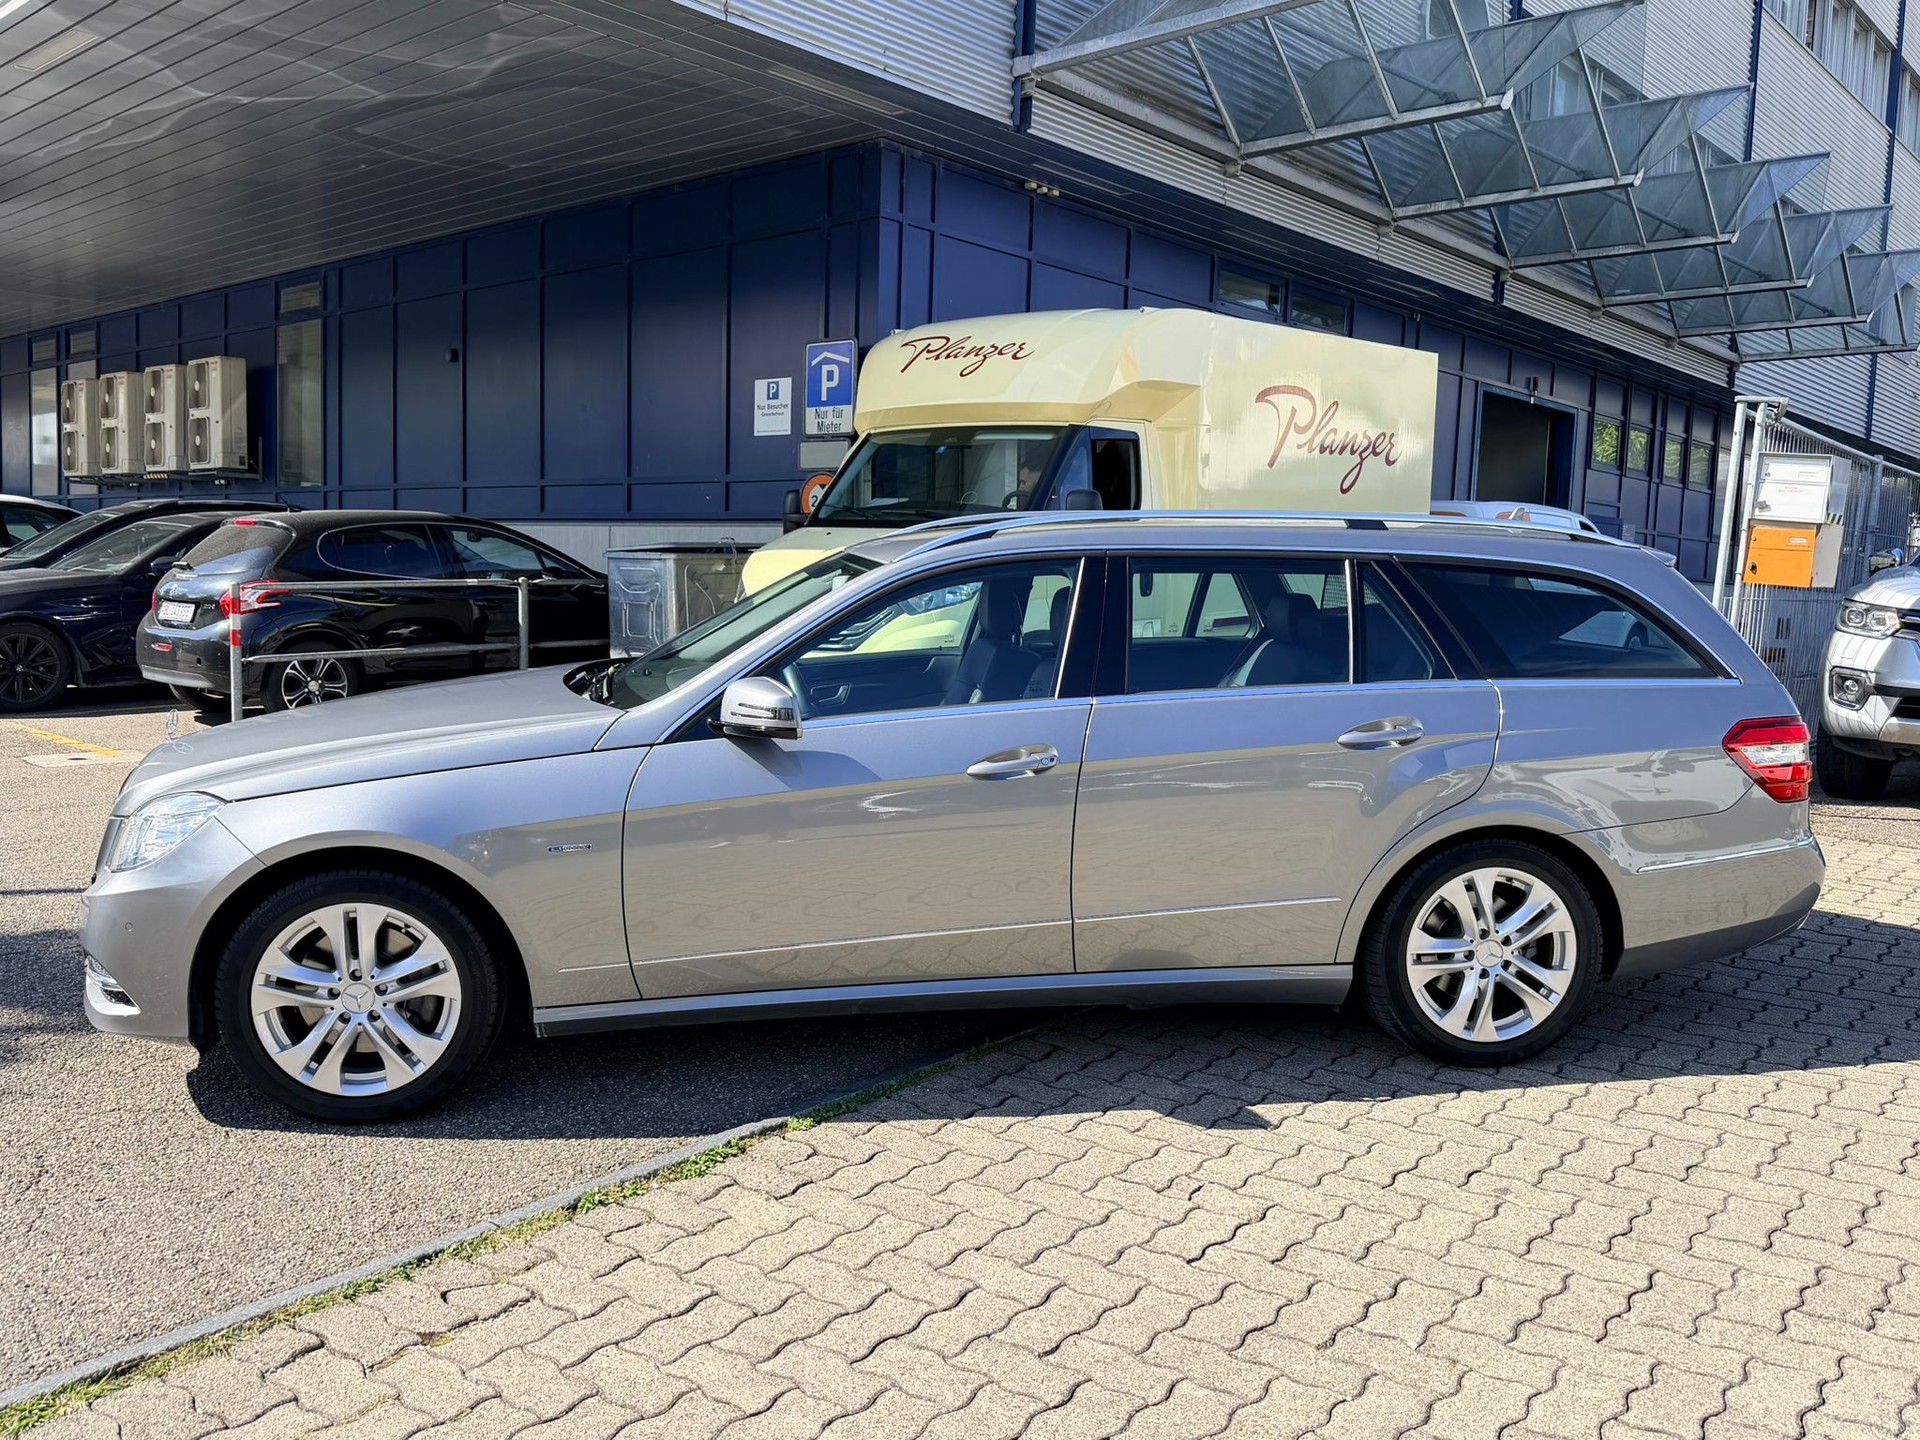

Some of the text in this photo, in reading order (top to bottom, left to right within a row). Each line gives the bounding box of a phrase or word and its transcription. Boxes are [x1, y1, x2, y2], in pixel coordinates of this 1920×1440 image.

[900, 335, 1035, 377] Planzer
[769, 383, 776, 398] P
[821, 364, 839, 401] P
[814, 406, 844, 420] Nur für
[816, 420, 842, 433] Mieter
[1255, 384, 1403, 495] Planzer
